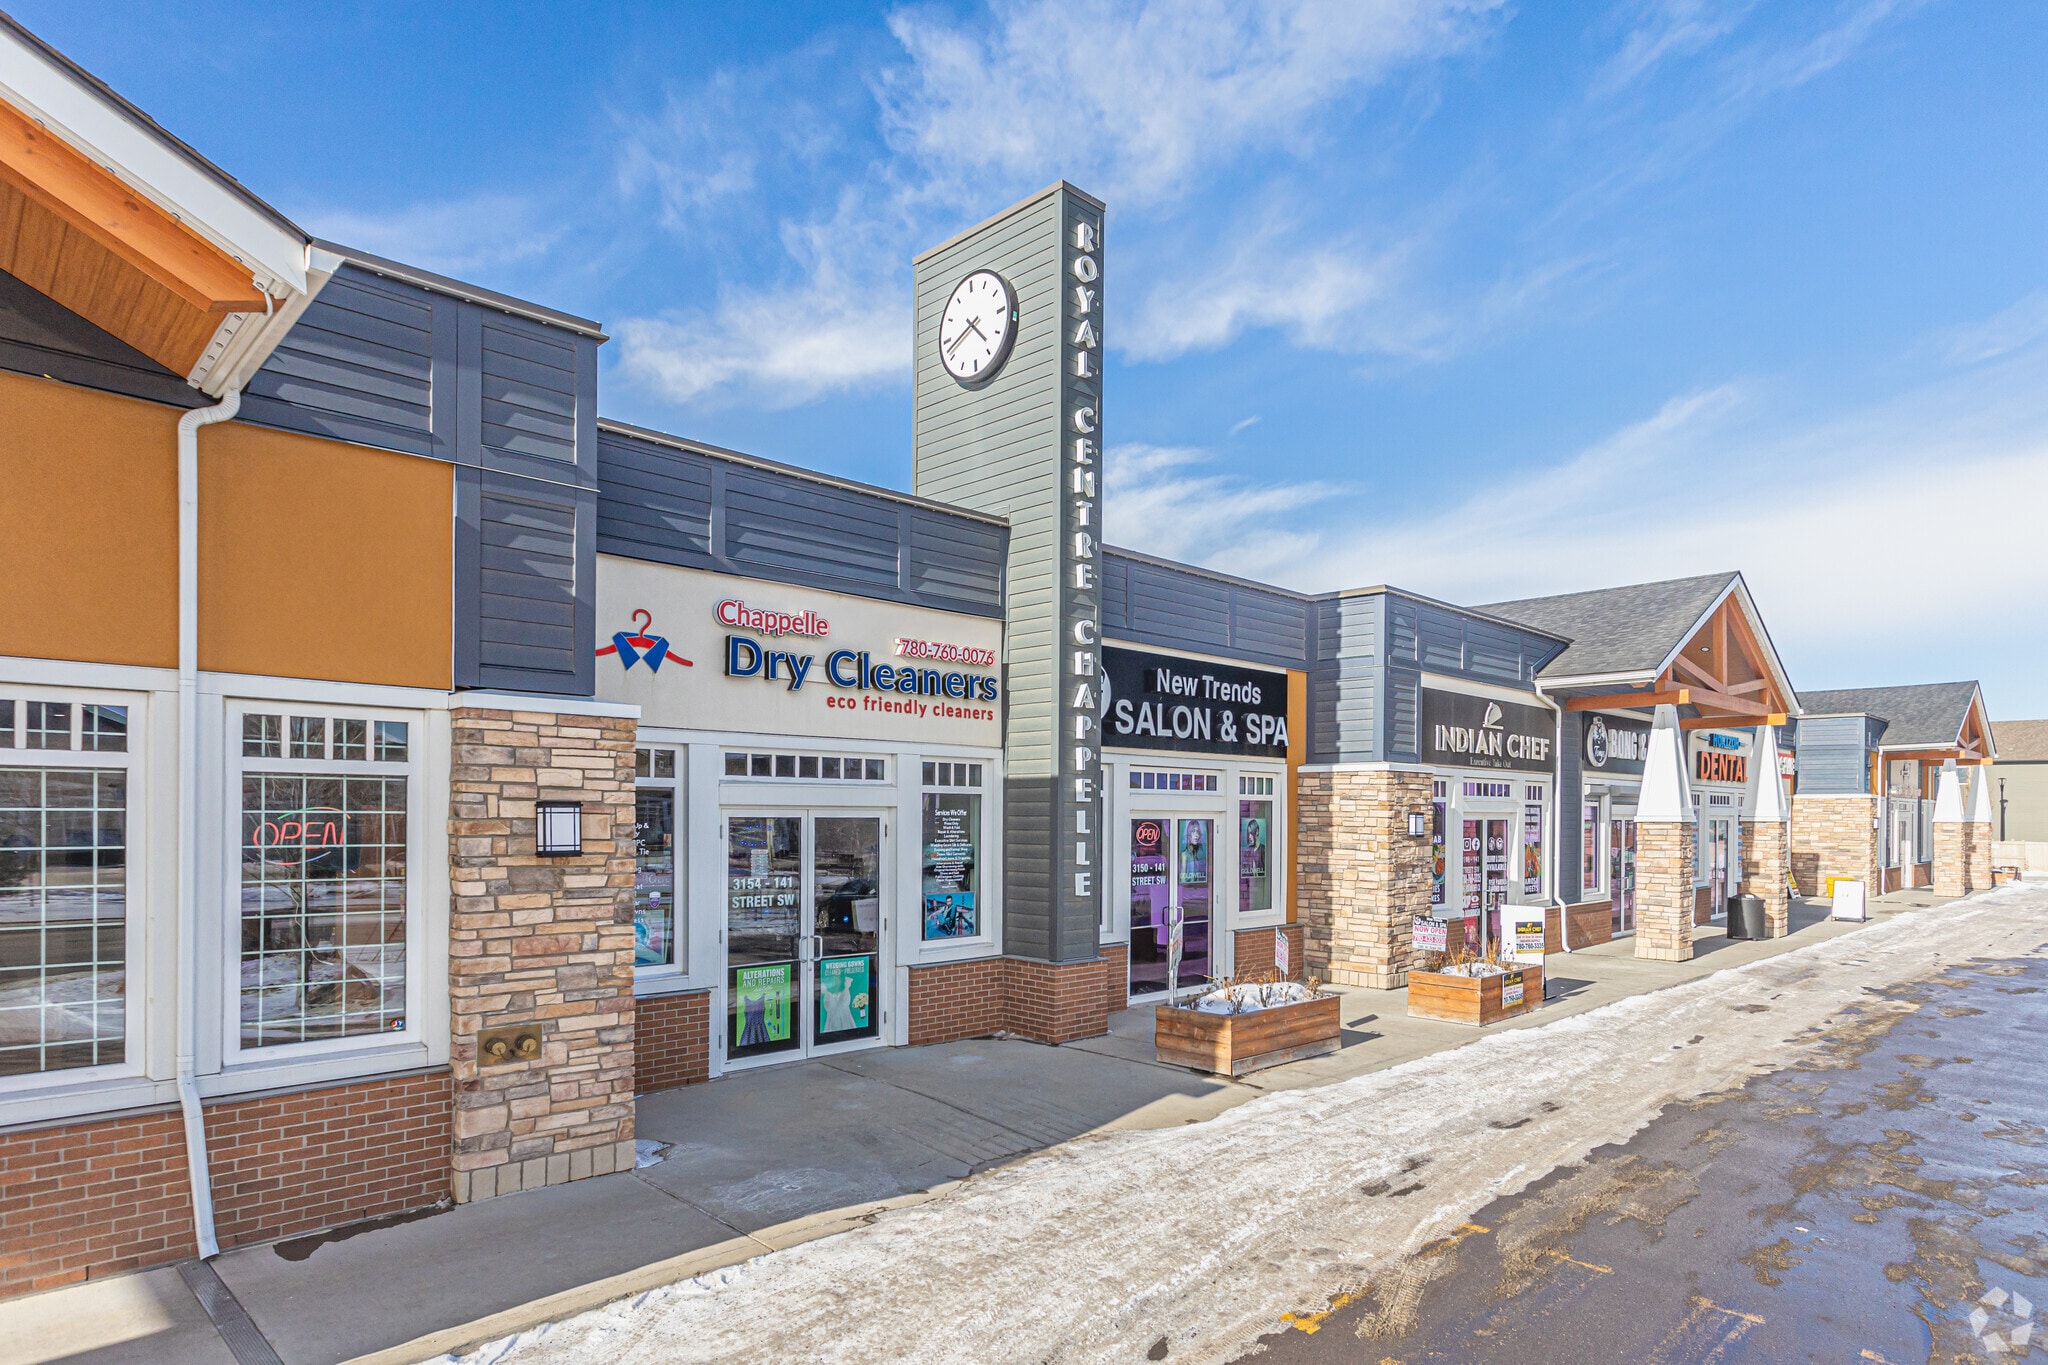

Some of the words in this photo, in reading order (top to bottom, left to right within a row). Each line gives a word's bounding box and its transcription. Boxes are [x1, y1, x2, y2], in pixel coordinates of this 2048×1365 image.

[1074, 221, 1098, 378] ROYAL
[1073, 406, 1095, 589] CENTRE
[716, 599, 830, 636] Chappelle
[898, 639, 996, 666] 780-760-0076
[726, 635, 815, 691] Dry
[826, 648, 998, 701] Cleaners
[1156, 668, 1199, 697] New
[1202, 675, 1262, 705] Trends
[826, 695, 857, 710] eco
[863, 695, 927, 718] friendly
[933, 702, 994, 721] cleaners
[1115, 699, 1211, 740] SALON
[1220, 710, 1237, 742] &
[1246, 713, 1289, 746] SPA
[1435, 724, 1503, 757] INDIAN
[1507, 733, 1550, 761] CHEF
[1607, 728, 1638, 760] BONG
[1073, 619, 1095, 896] CHAPPELLE
[1697, 751, 1748, 783] DENTAL
[252, 821, 345, 850] OPEN
[1138, 828, 1158, 841] OPEN
[1131, 875, 1156, 886] STREET
[1156, 875, 1167, 885] SW
[1132, 863, 1149, 873] 3150
[1155, 863, 1165, 872] 141
[732, 877, 761, 891] 3154
[774, 876, 793, 889] 141
[732, 895, 775, 909] STREET
[777, 893, 795, 907] SW
[1415, 925, 1429, 934] NOW
[1430, 926, 1447, 935] OPEN
[743, 968, 785, 981] ALTERATIONS
[743, 979, 756, 988] AND
[758, 975, 785, 986] REPAIRS
